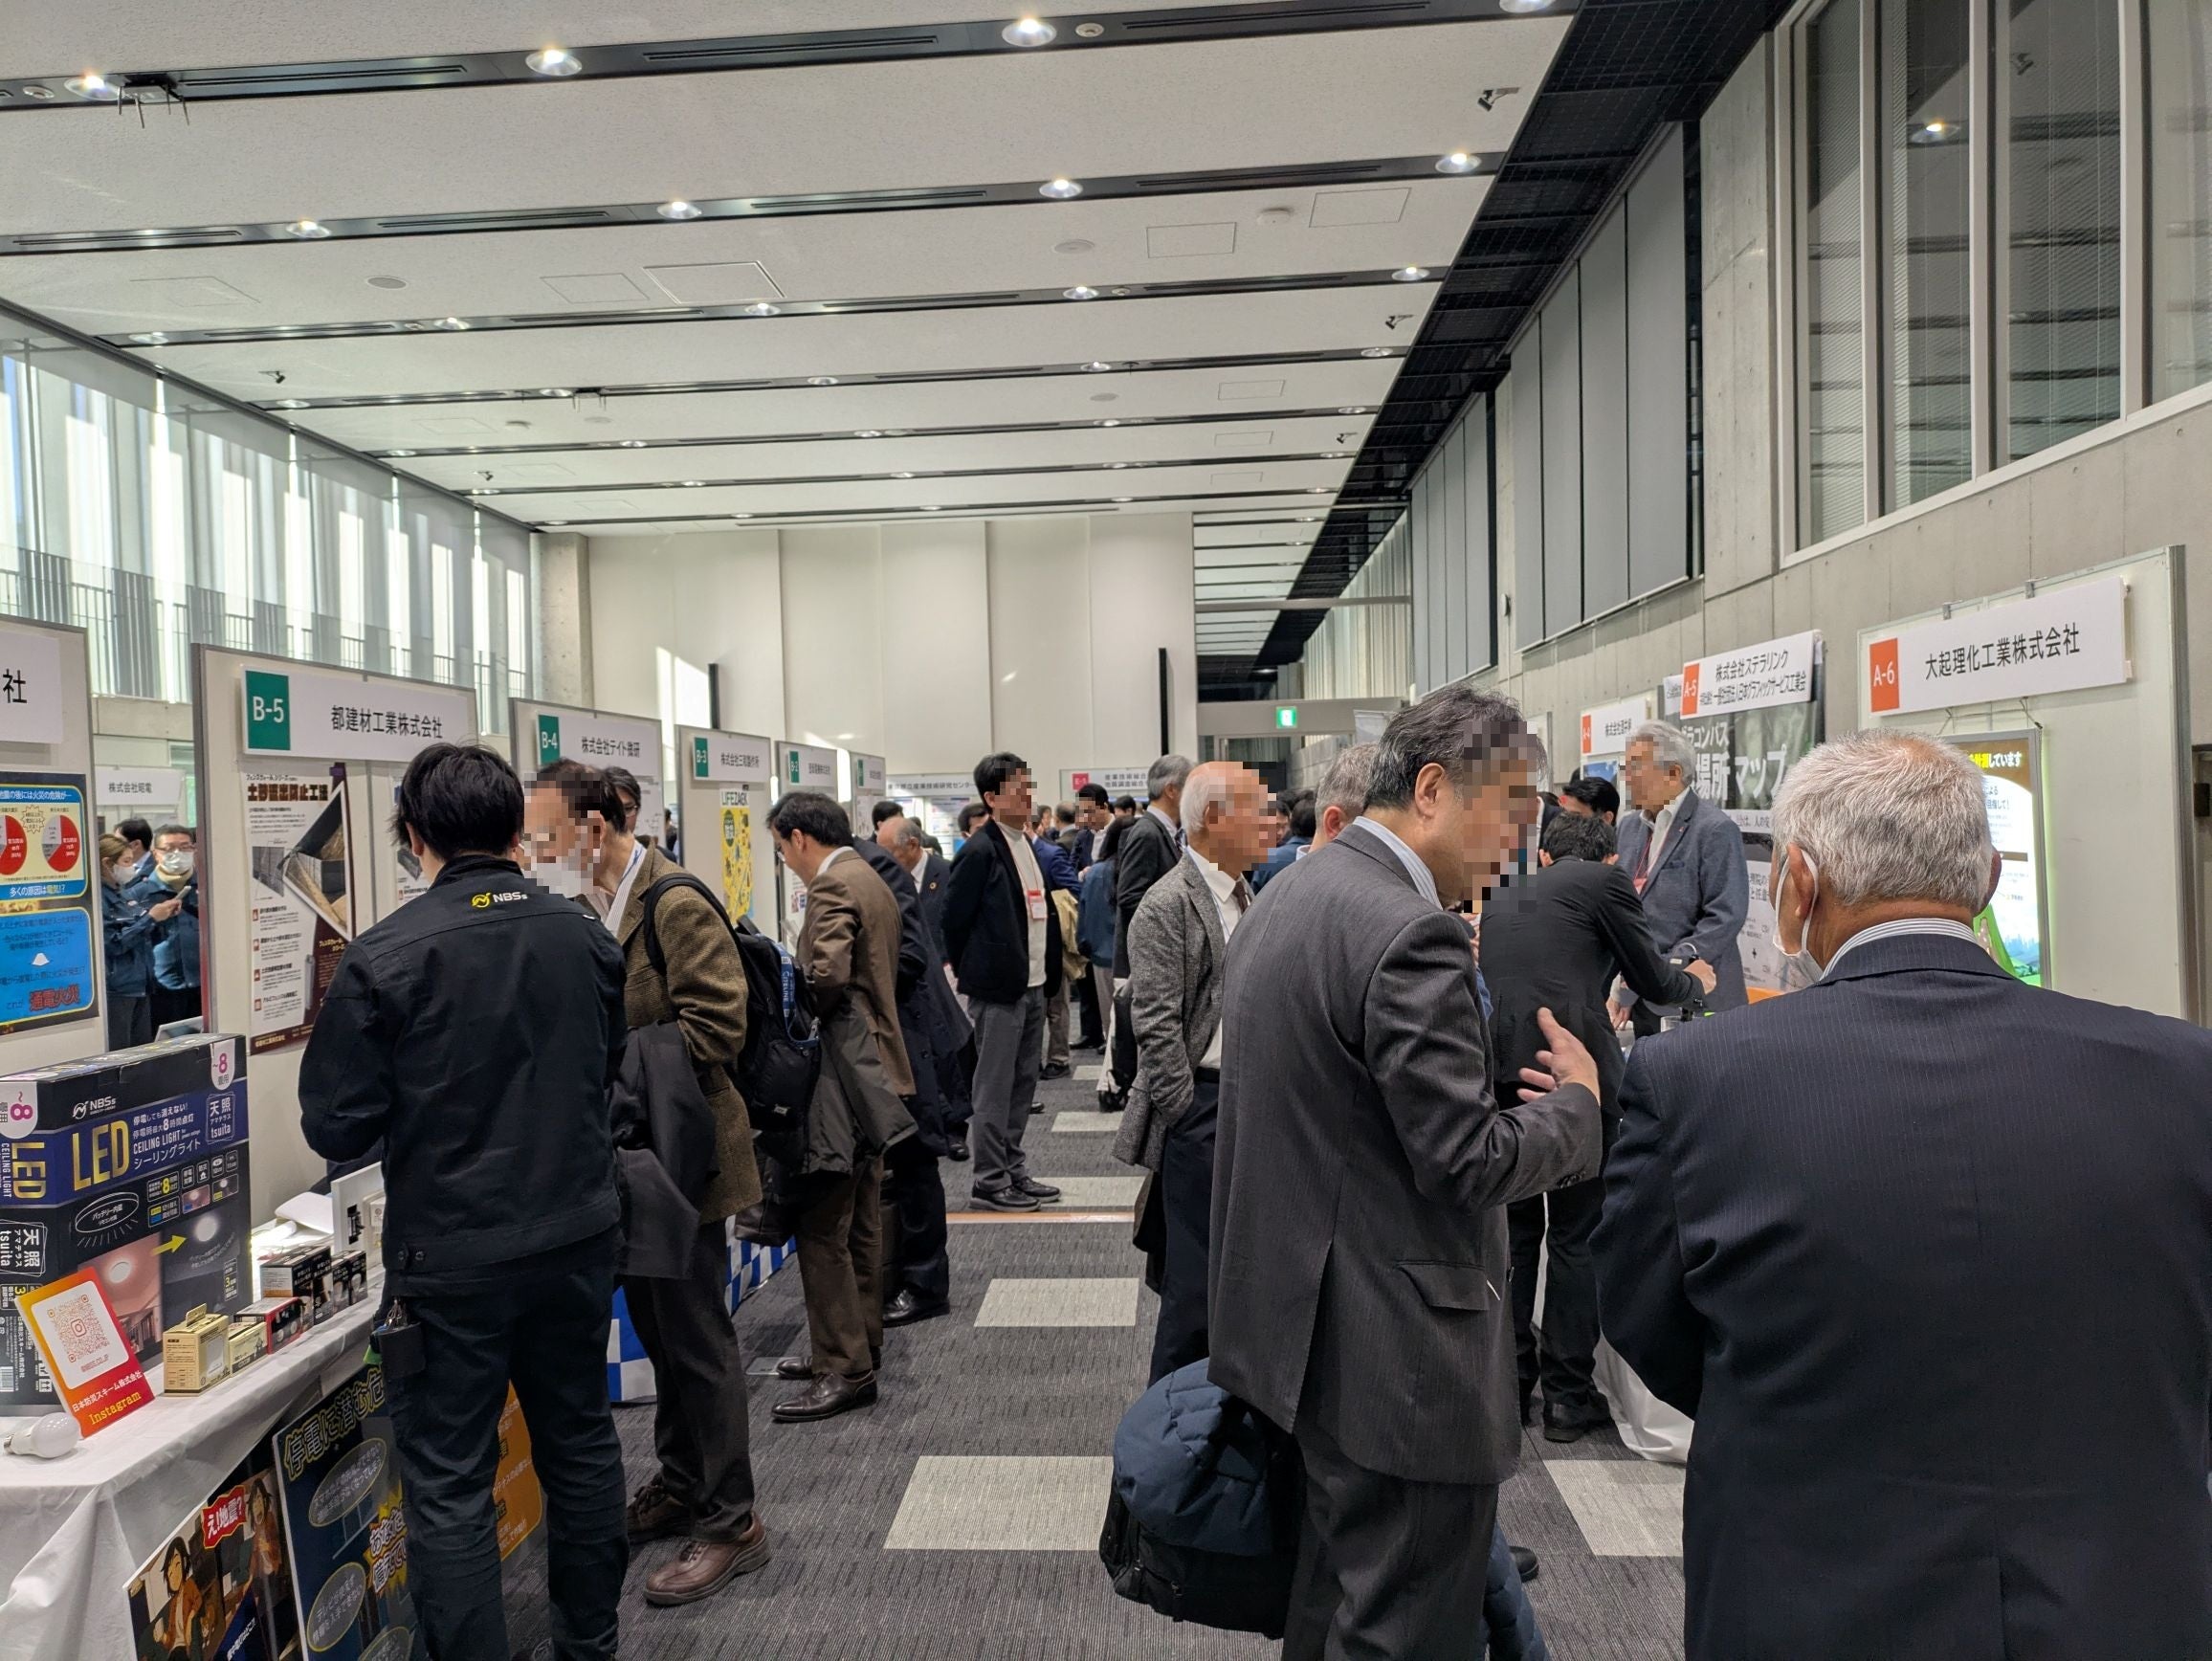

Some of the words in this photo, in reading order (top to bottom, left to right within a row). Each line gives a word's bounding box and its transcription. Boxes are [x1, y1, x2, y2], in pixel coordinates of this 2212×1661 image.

[1925, 622, 2082, 680] 大起理化工業株式会社
[1715, 650, 1789, 682] 株式会社ステラリンク
[1872, 660, 1895, 687] A-6
[2, 668, 28, 704] 社
[1683, 680, 1697, 698] A-5
[253, 696, 284, 724] B-5
[331, 704, 443, 740] 都建材工業株式会社
[541, 731, 559, 750] B-4
[1682, 721, 1730, 749] ラコンパス
[696, 748, 708, 764] B-3
[108, 782, 153, 795] 株式会社昭電
[493, 891, 528, 903] NBSs
[30, 984, 80, 1012] 通電火災
[90, 1096, 117, 1111] NBSs
[210, 1096, 232, 1118] 天照
[133, 1136, 160, 1155] CEILING
[162, 1131, 181, 1146] LIGHT
[210, 1124, 232, 1139] tsuita
[1, 1142, 11, 1174] CEILING
[72, 1119, 130, 1192] LED
[134, 1139, 202, 1170] シーリングライト
[11, 1141, 47, 1199] LED
[2, 1176, 12, 1198] LIGHT
[0, 1230, 12, 1267] tsuita
[23, 1229, 40, 1268] 天照
[72, 1369, 143, 1413] 日本防災スキーム株式会社
[88, 1391, 142, 1426] Instagram
[208, 1495, 244, 1540] え!地震?
